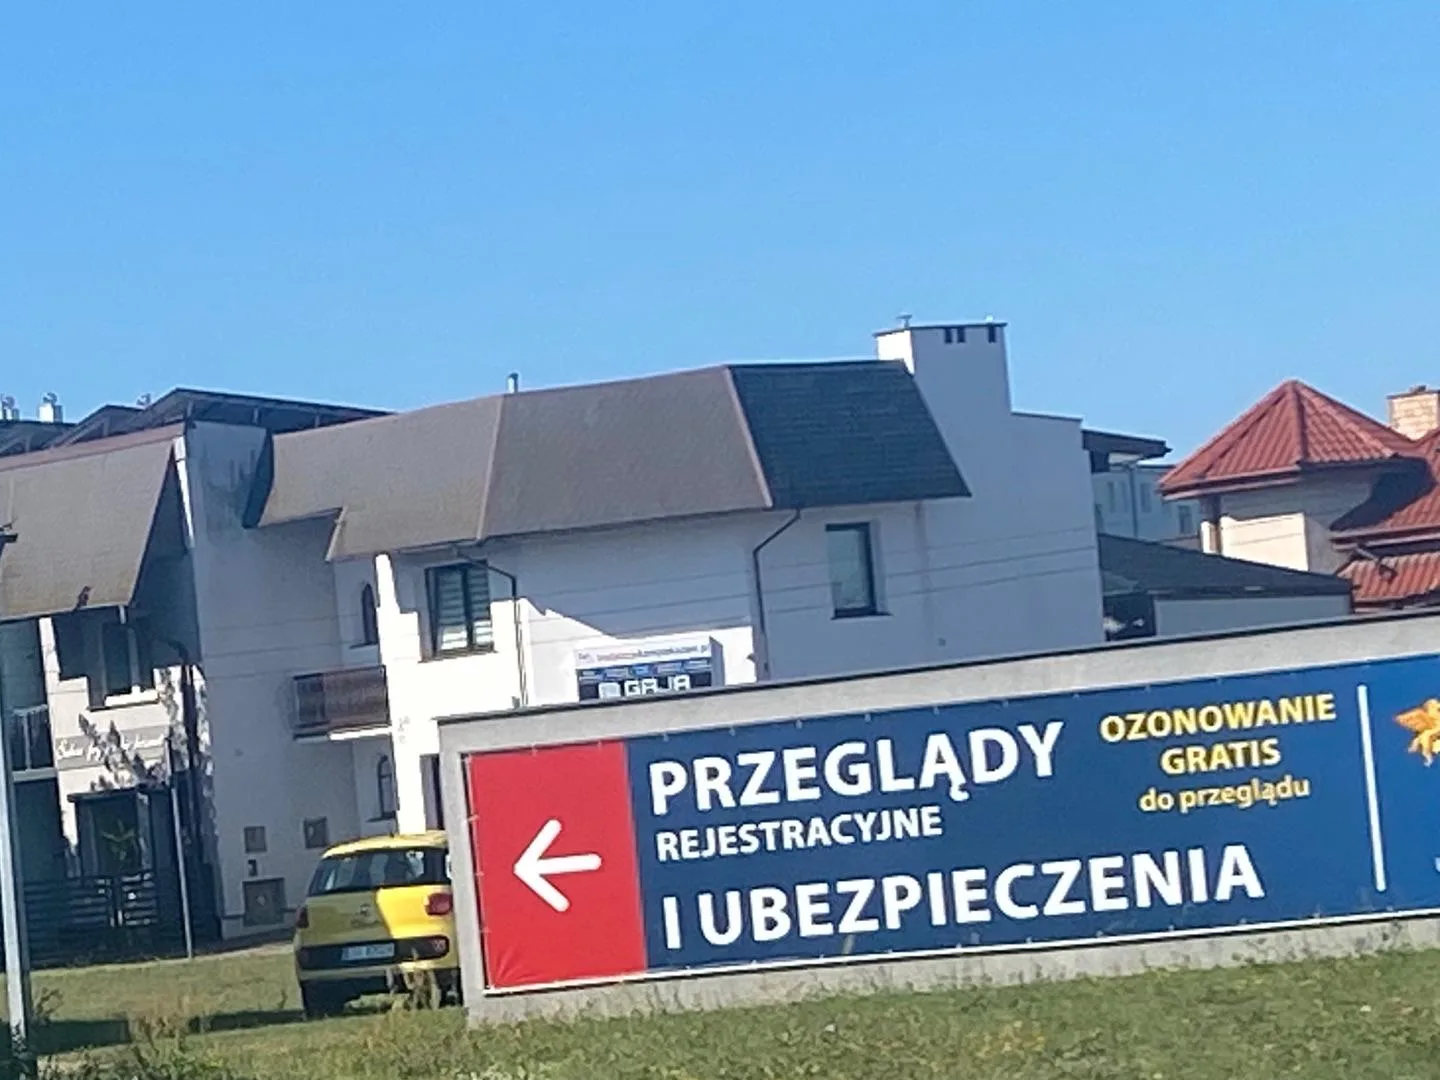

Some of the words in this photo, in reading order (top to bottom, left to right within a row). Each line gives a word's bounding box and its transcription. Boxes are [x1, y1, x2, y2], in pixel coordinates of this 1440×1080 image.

[1099, 692, 1337, 743] OZONOWANIE
[648, 720, 1064, 817] PRZEGLĄDY
[1160, 737, 1282, 776] GRATIS
[1138, 786, 1175, 813] do
[1179, 773, 1311, 815] przeglądu
[654, 804, 944, 862] REJESTRACYJNE
[662, 896, 682, 950] I
[697, 843, 1266, 947] UBEZPIECZENIA
